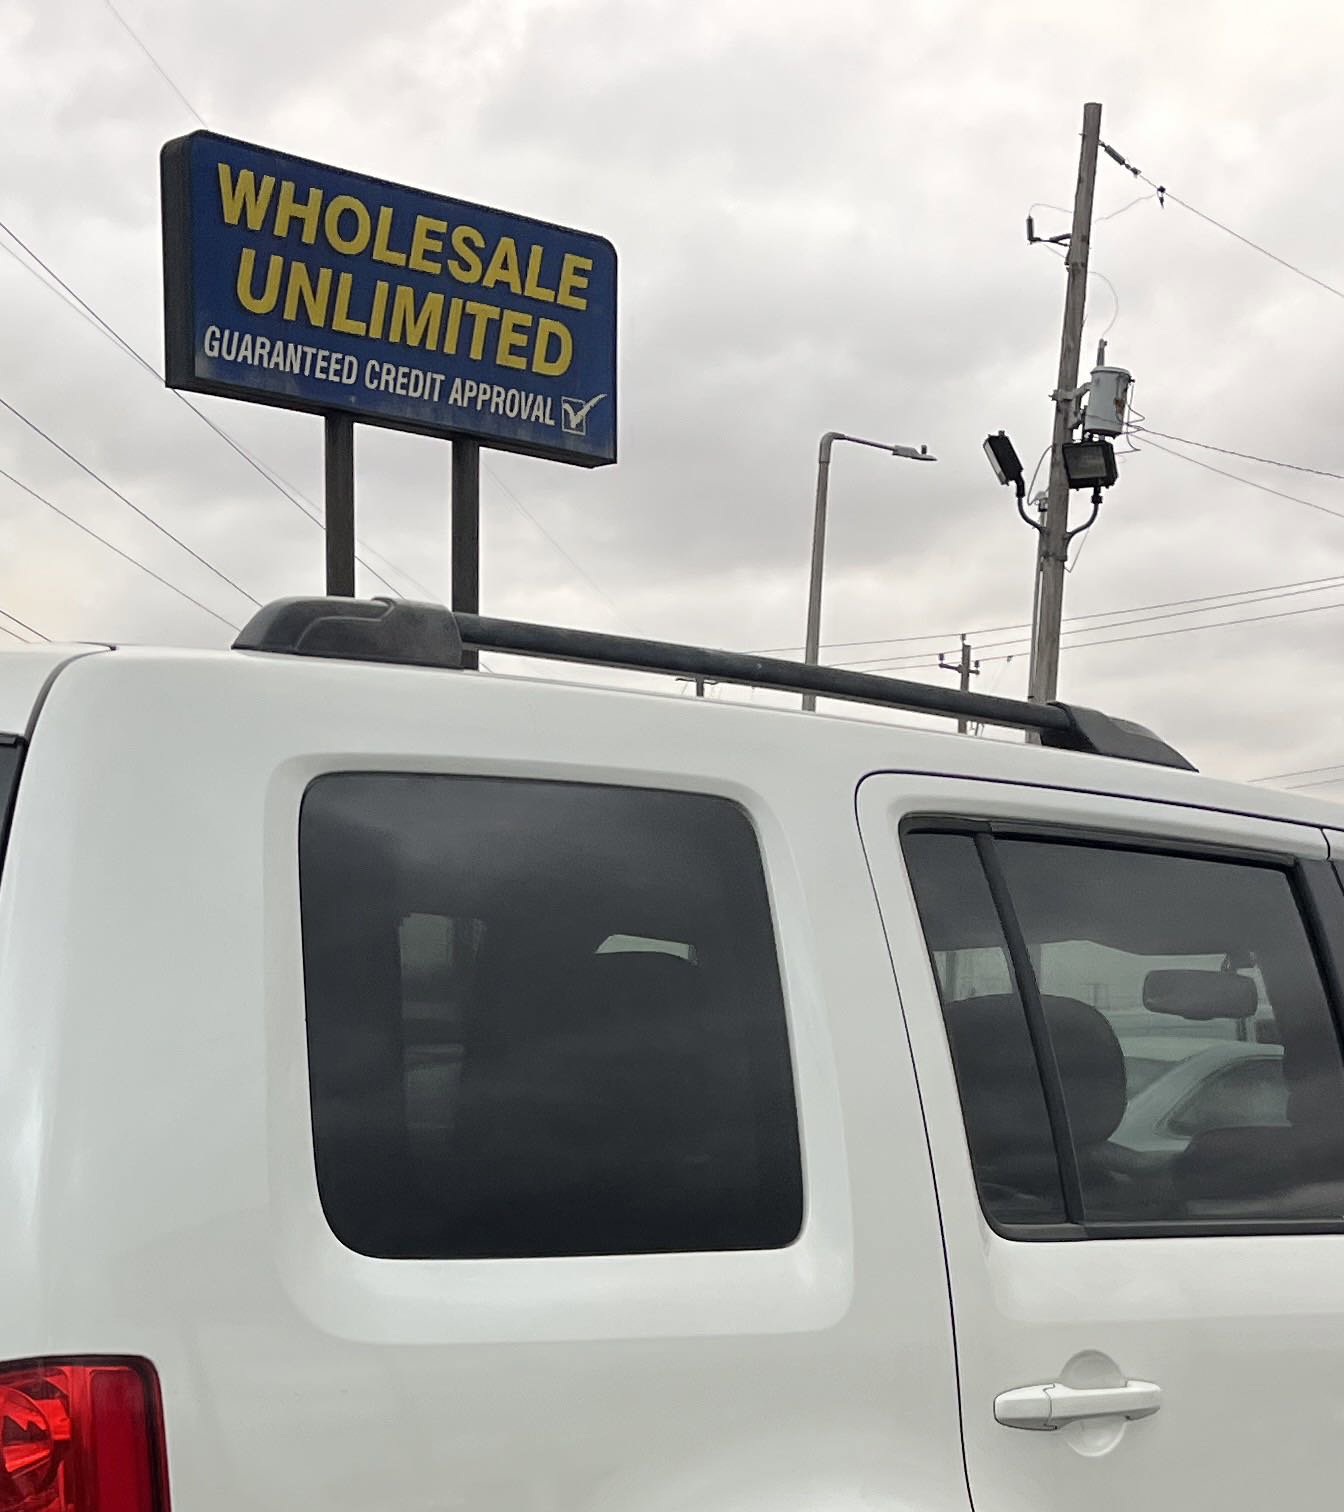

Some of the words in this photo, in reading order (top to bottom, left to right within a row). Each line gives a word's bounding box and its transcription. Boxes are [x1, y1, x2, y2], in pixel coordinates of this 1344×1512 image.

[218, 162, 593, 311] WHOLESALE
[204, 325, 357, 385] GUARANTEED
[365, 359, 445, 402] CREDIT
[448, 376, 555, 426] APPROVAL
[236, 247, 573, 376] UNLIMITED
